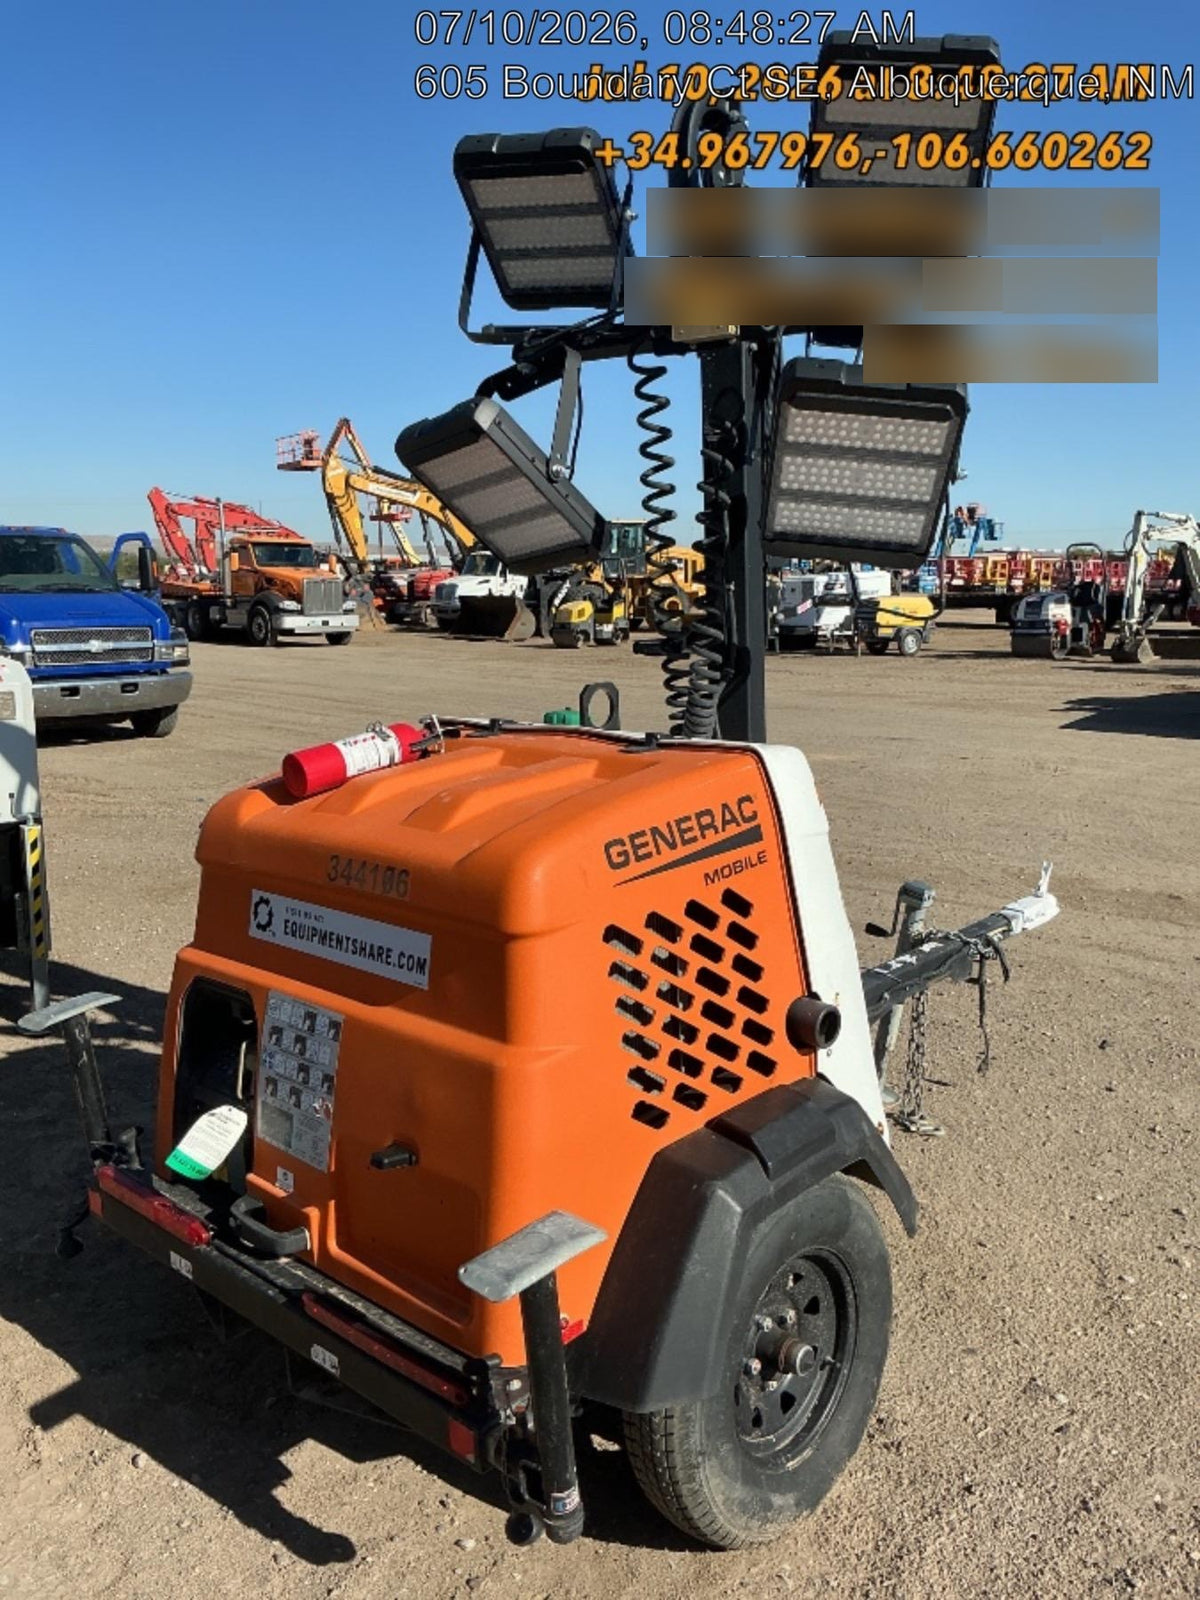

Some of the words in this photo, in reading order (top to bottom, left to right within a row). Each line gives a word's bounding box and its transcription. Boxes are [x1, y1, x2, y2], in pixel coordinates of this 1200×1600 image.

[604, 795, 758, 870] GENERAC
[703, 850, 768, 886] MOBILE
[283, 919, 427, 977] EQUIPMENTSHARE.COM
